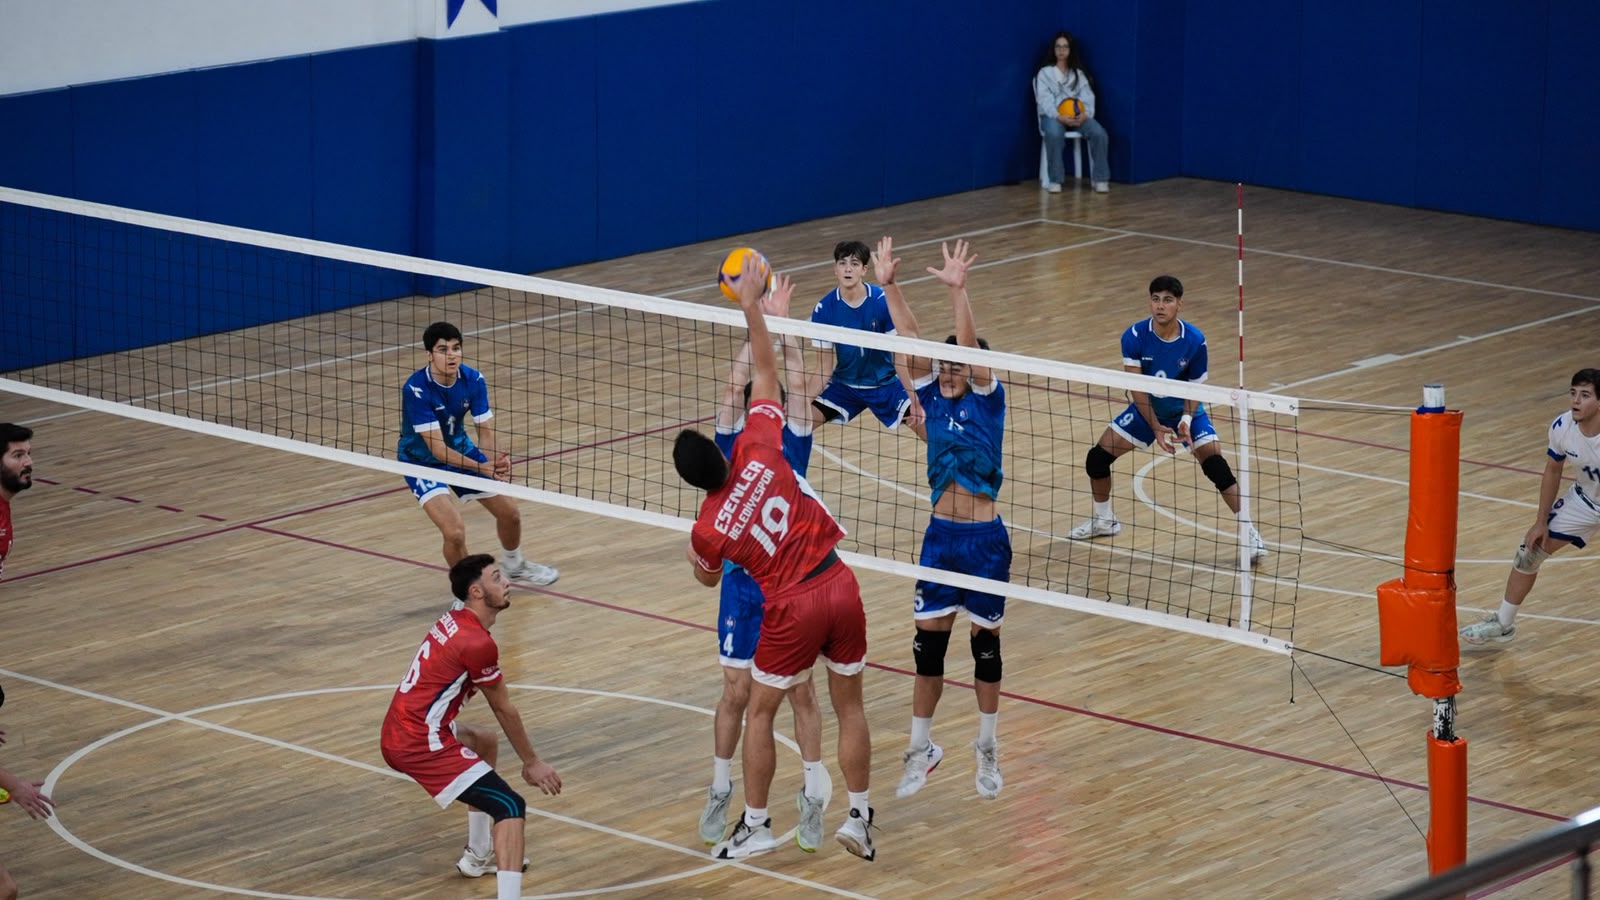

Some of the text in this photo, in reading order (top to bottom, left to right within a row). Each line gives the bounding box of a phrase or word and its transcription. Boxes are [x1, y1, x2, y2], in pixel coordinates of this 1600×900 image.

[1119, 412, 1134, 427] 9
[714, 460, 765, 535] ESENLER
[750, 495, 790, 557] 19
[723, 632, 734, 656] 4
